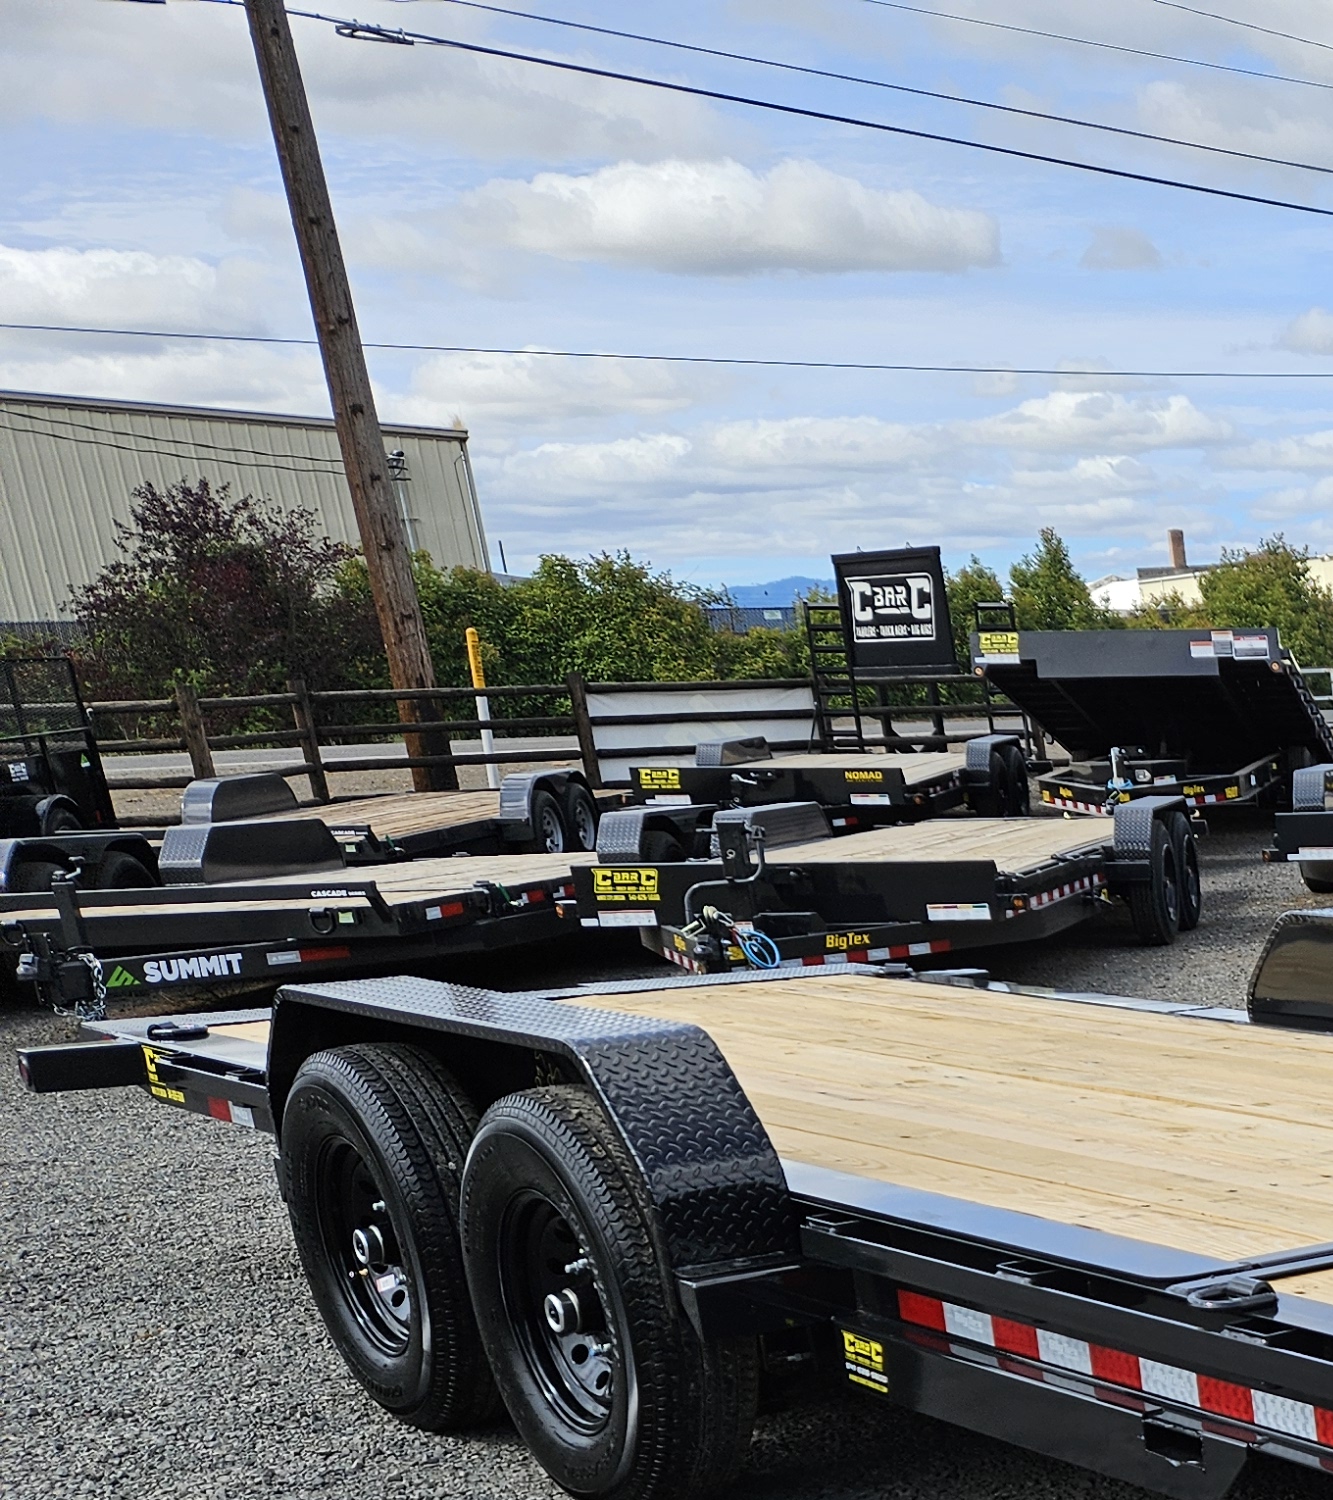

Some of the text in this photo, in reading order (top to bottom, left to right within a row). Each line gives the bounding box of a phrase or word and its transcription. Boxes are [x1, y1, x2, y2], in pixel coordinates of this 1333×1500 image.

[849, 577, 931, 621] C BAR C
[844, 771, 883, 780] NOMAD
[311, 889, 347, 897] CASCADE
[825, 932, 870, 949] BigTex
[143, 953, 243, 983] SUMMIT
